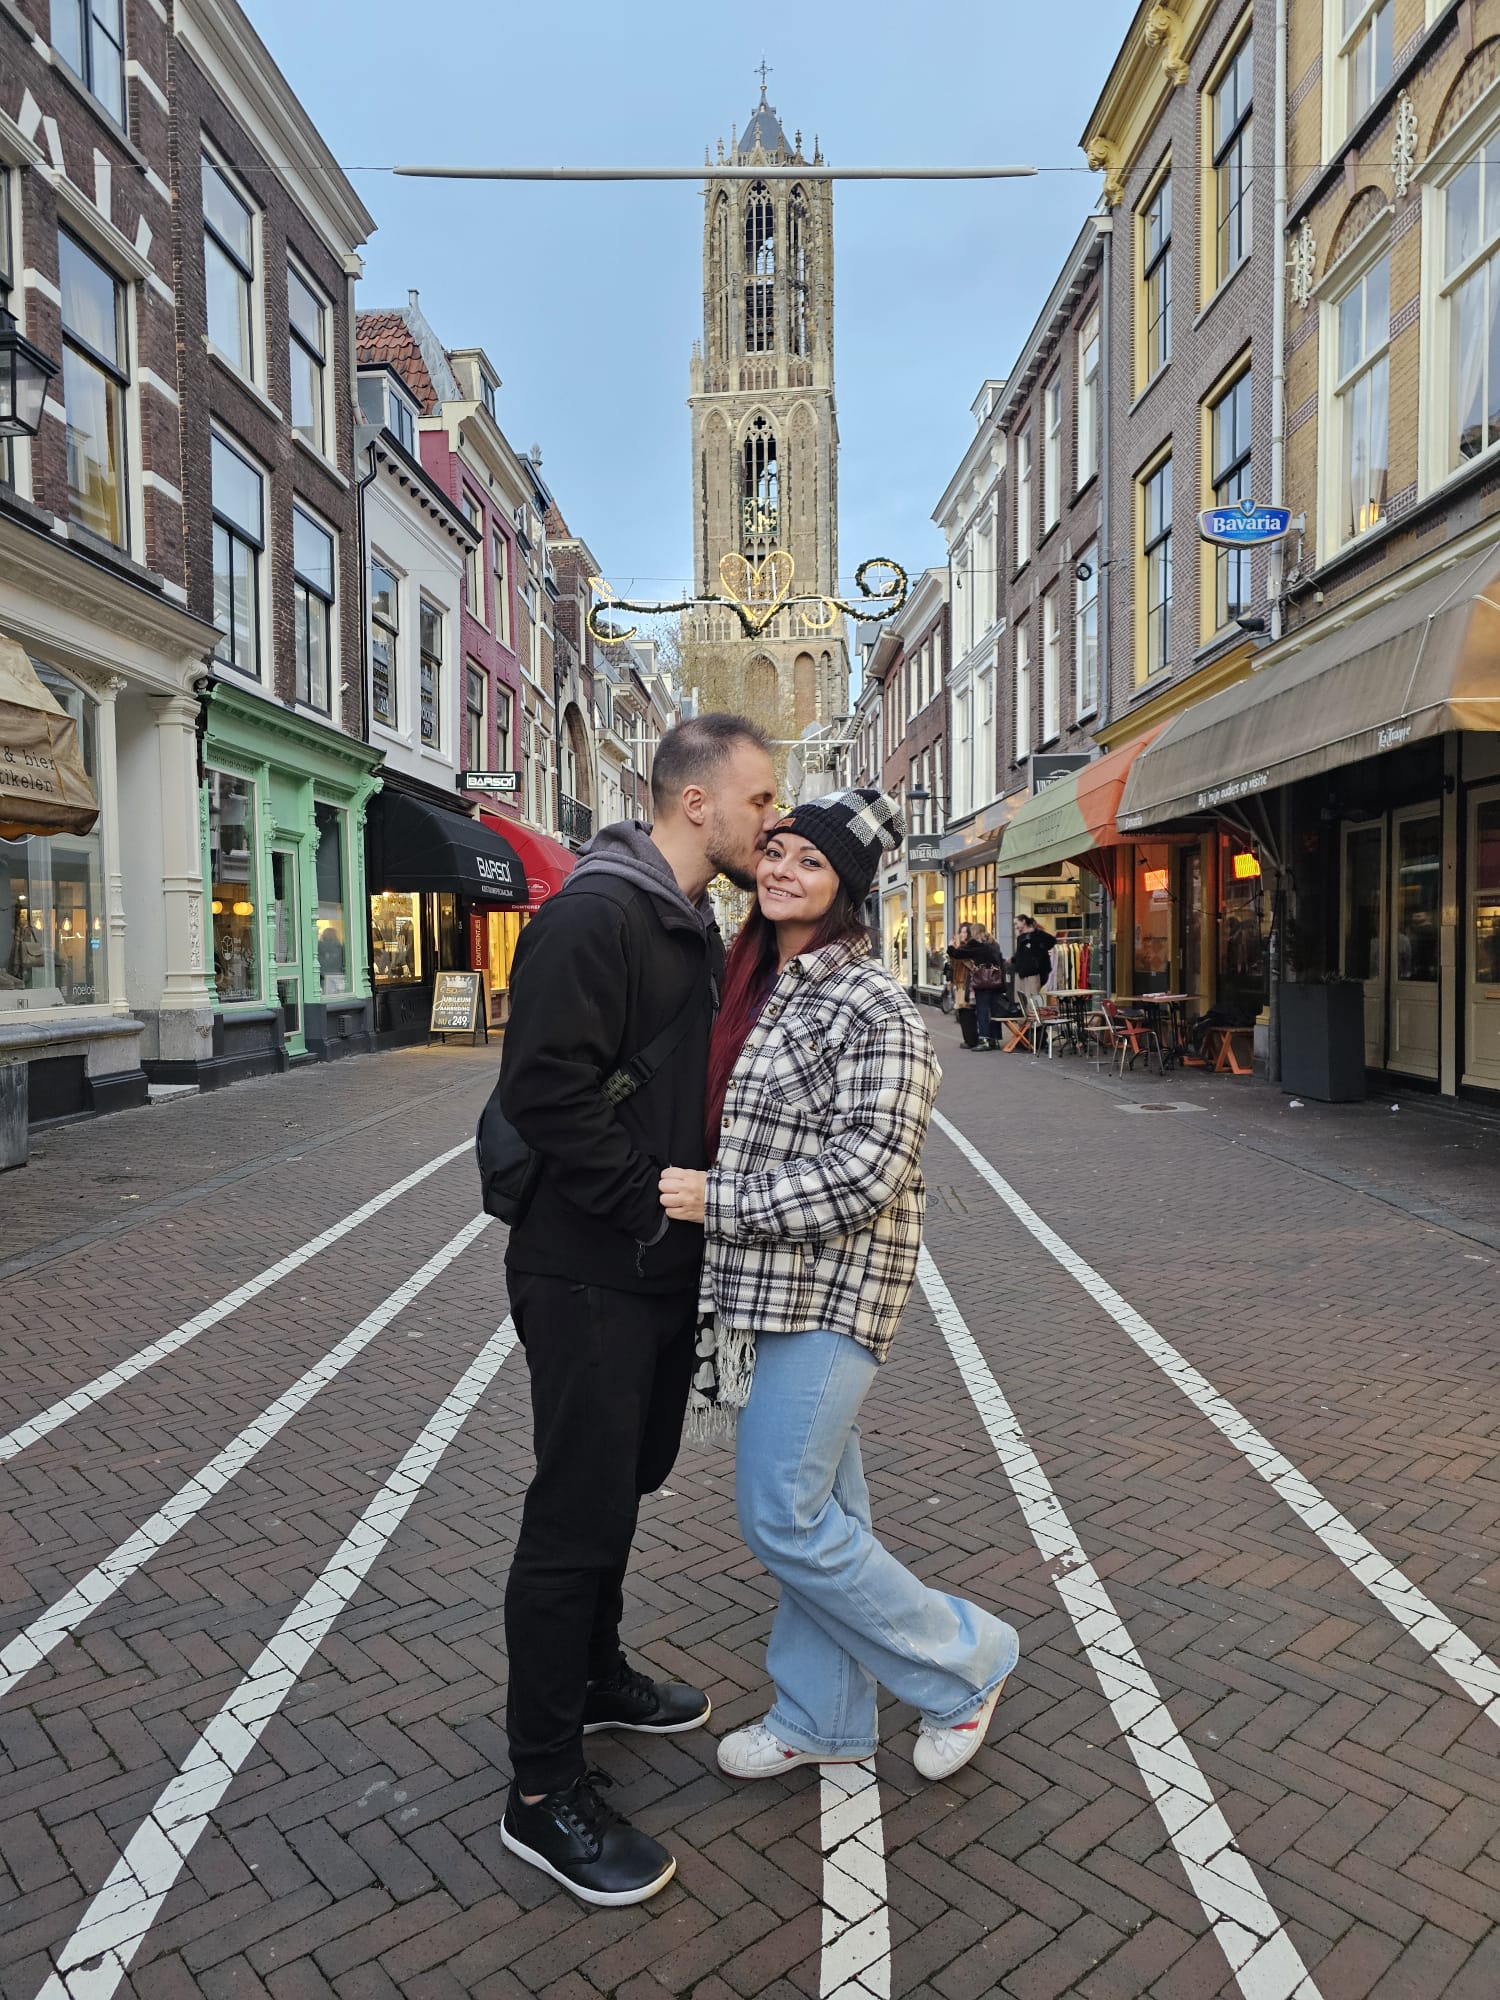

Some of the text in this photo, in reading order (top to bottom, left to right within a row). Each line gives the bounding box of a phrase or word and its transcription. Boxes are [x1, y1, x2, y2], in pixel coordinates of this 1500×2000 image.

[1213, 515, 1282, 533] Bavaria
[4, 745, 55, 770] & bier
